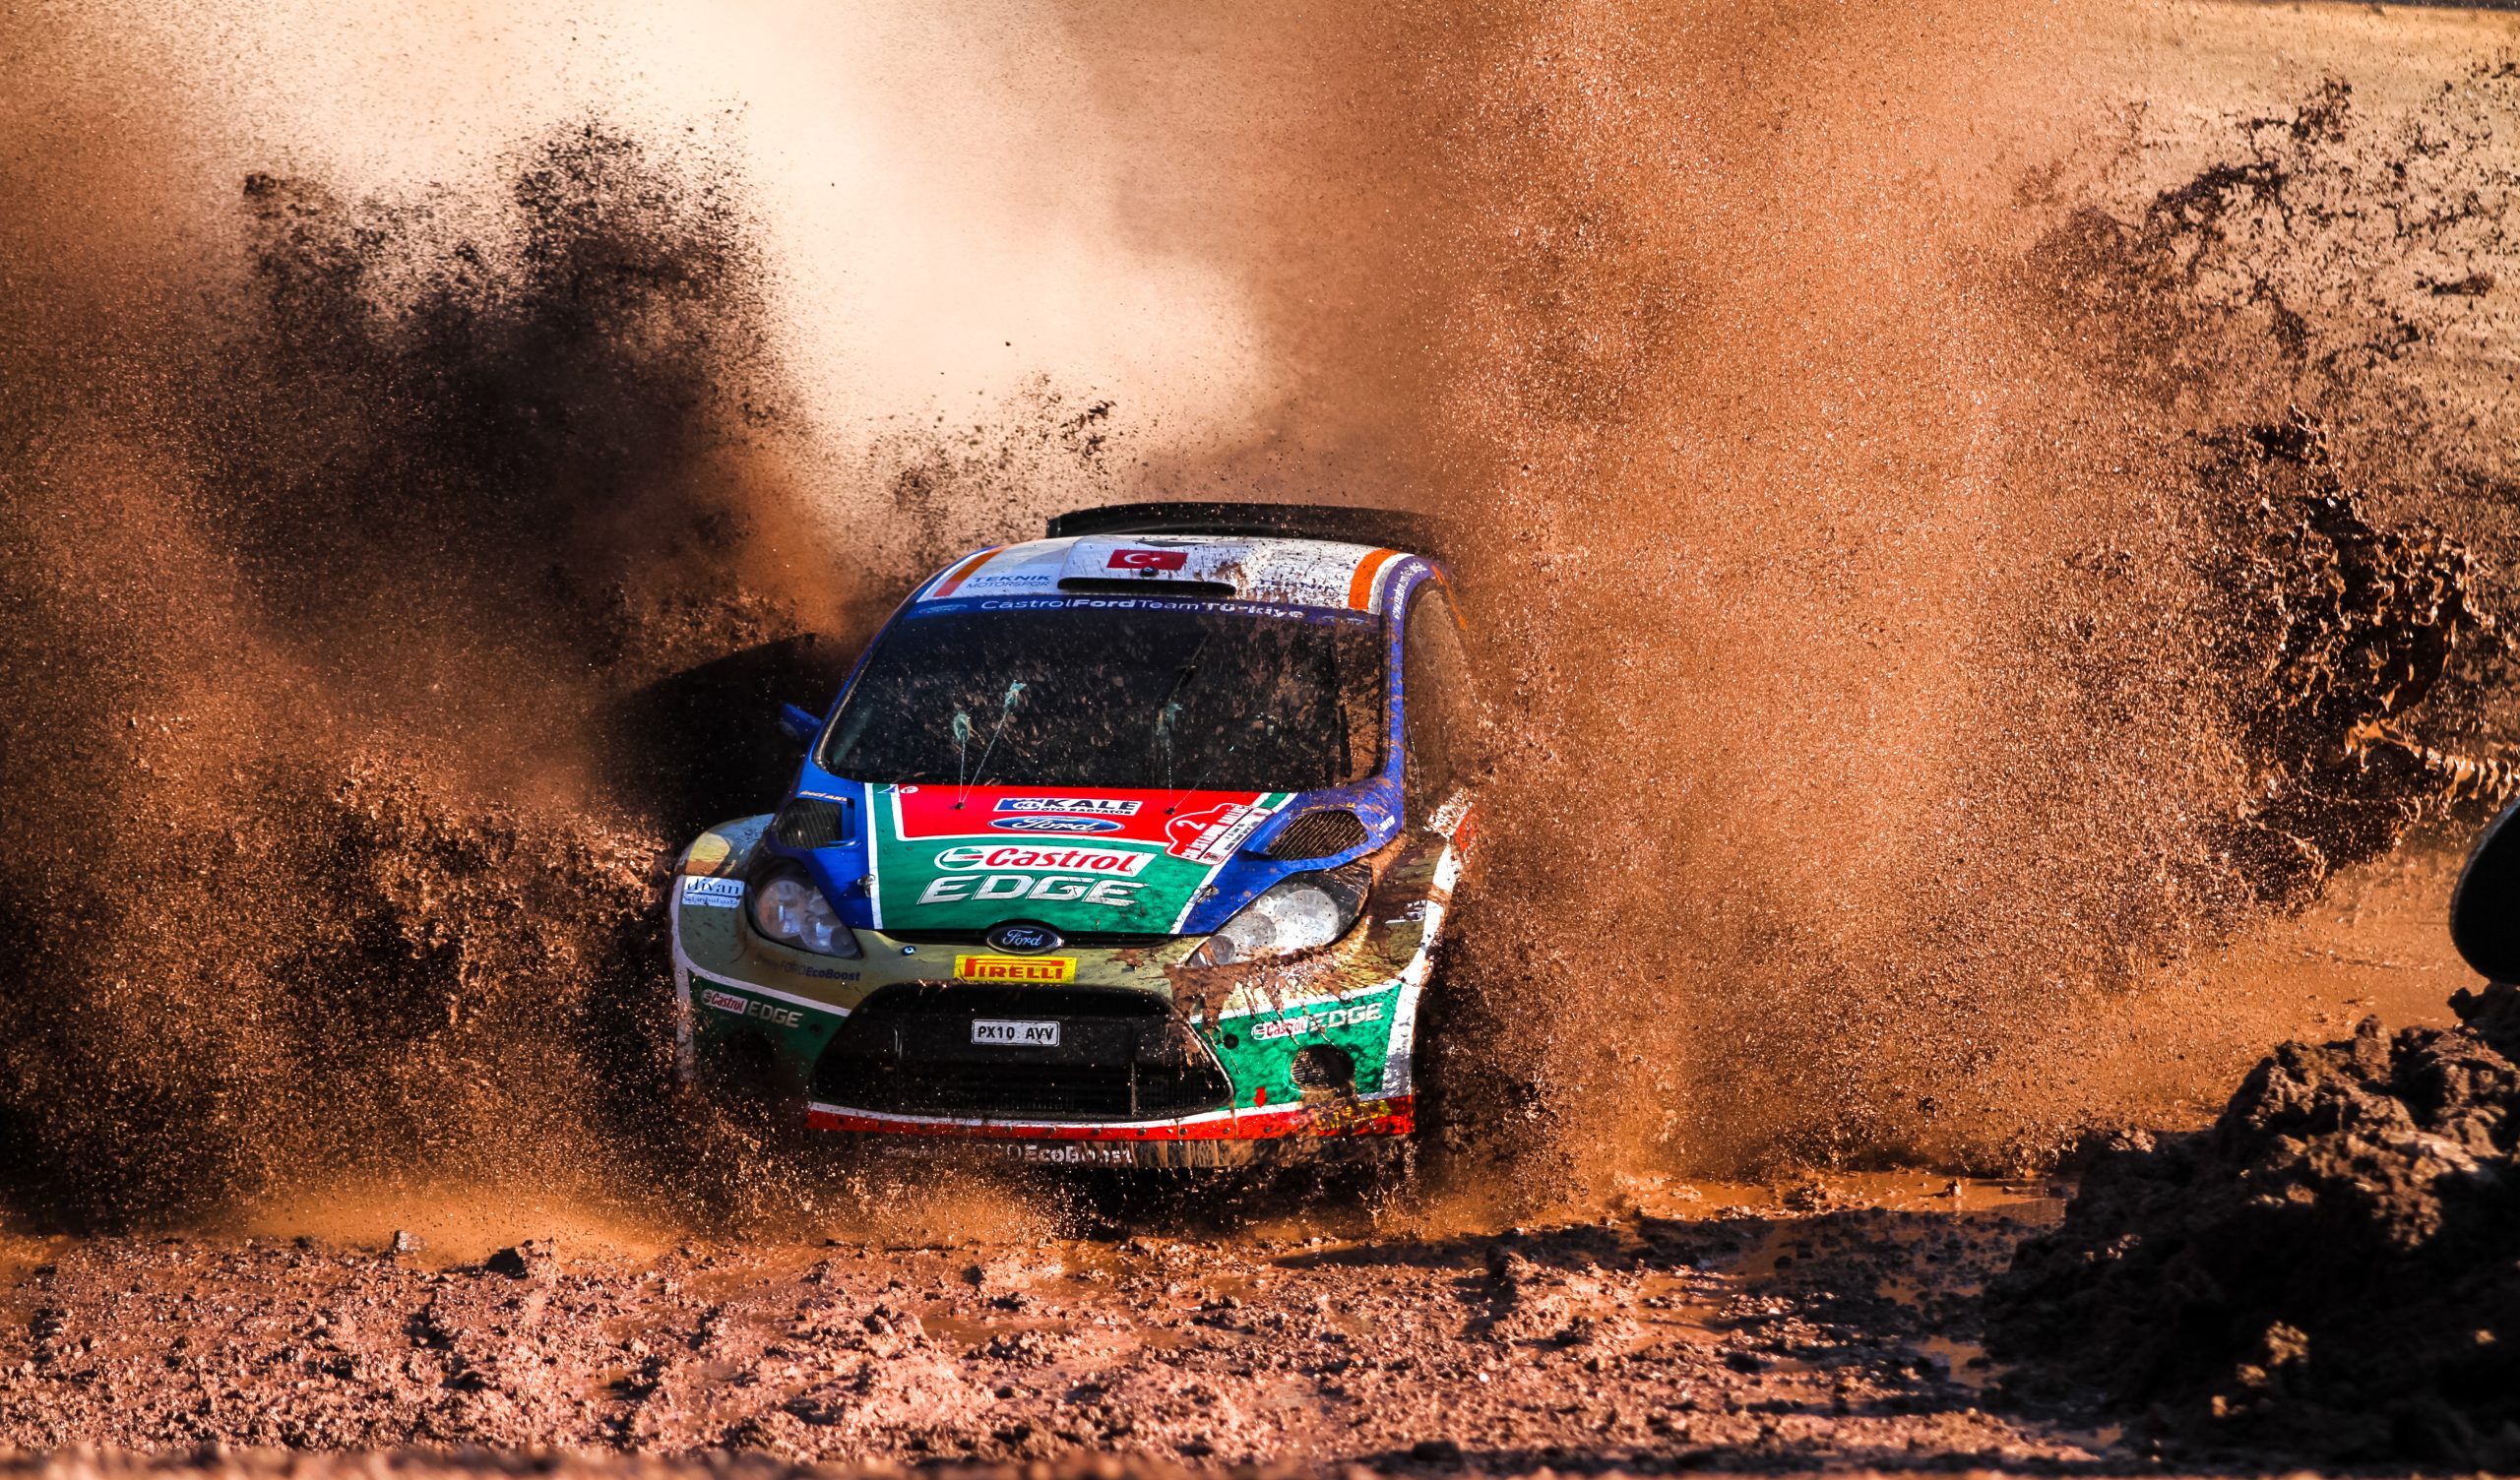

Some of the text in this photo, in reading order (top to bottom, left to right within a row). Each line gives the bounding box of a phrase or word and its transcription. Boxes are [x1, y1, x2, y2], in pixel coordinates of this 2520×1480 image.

[1044, 799, 1138, 811] KALE
[1011, 818, 1097, 832] Ford
[985, 848, 1138, 873] Castrol
[687, 878, 739, 894] divan
[916, 874, 1152, 906] EDGE
[1001, 929, 1043, 947] Ford
[964, 957, 1065, 979] PIRELLI
[712, 993, 803, 1028] Castrol EDGE
[977, 1026, 1054, 1040] PX10 AVV
[1266, 1019, 1306, 1036] Casol
